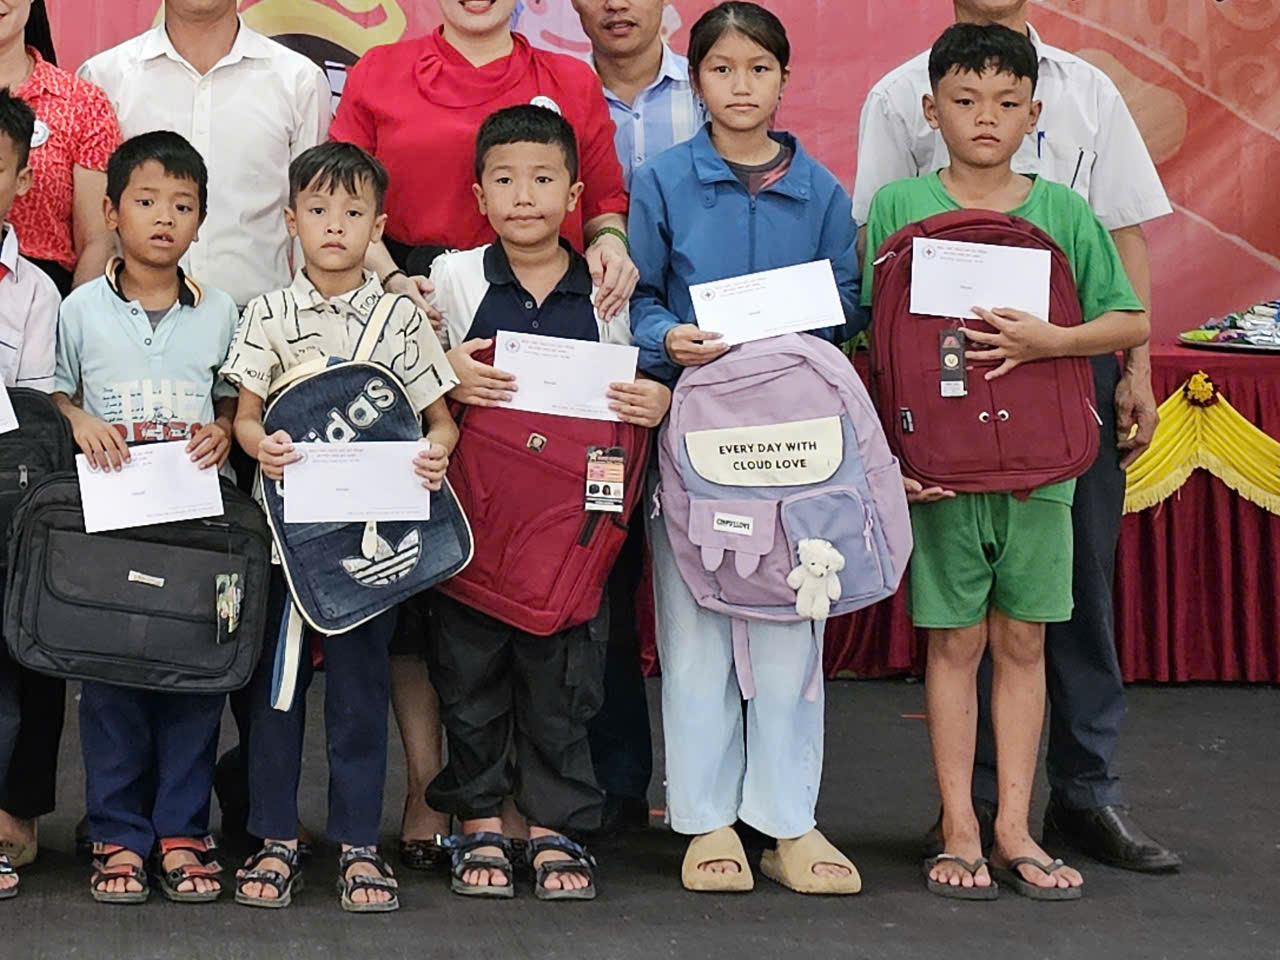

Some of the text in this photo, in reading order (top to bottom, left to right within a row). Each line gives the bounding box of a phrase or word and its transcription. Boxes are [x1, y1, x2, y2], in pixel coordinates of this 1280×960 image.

[719, 441, 817, 455] EVERY DAY WITH
[733, 458, 807, 470] CLOUD LOVE
